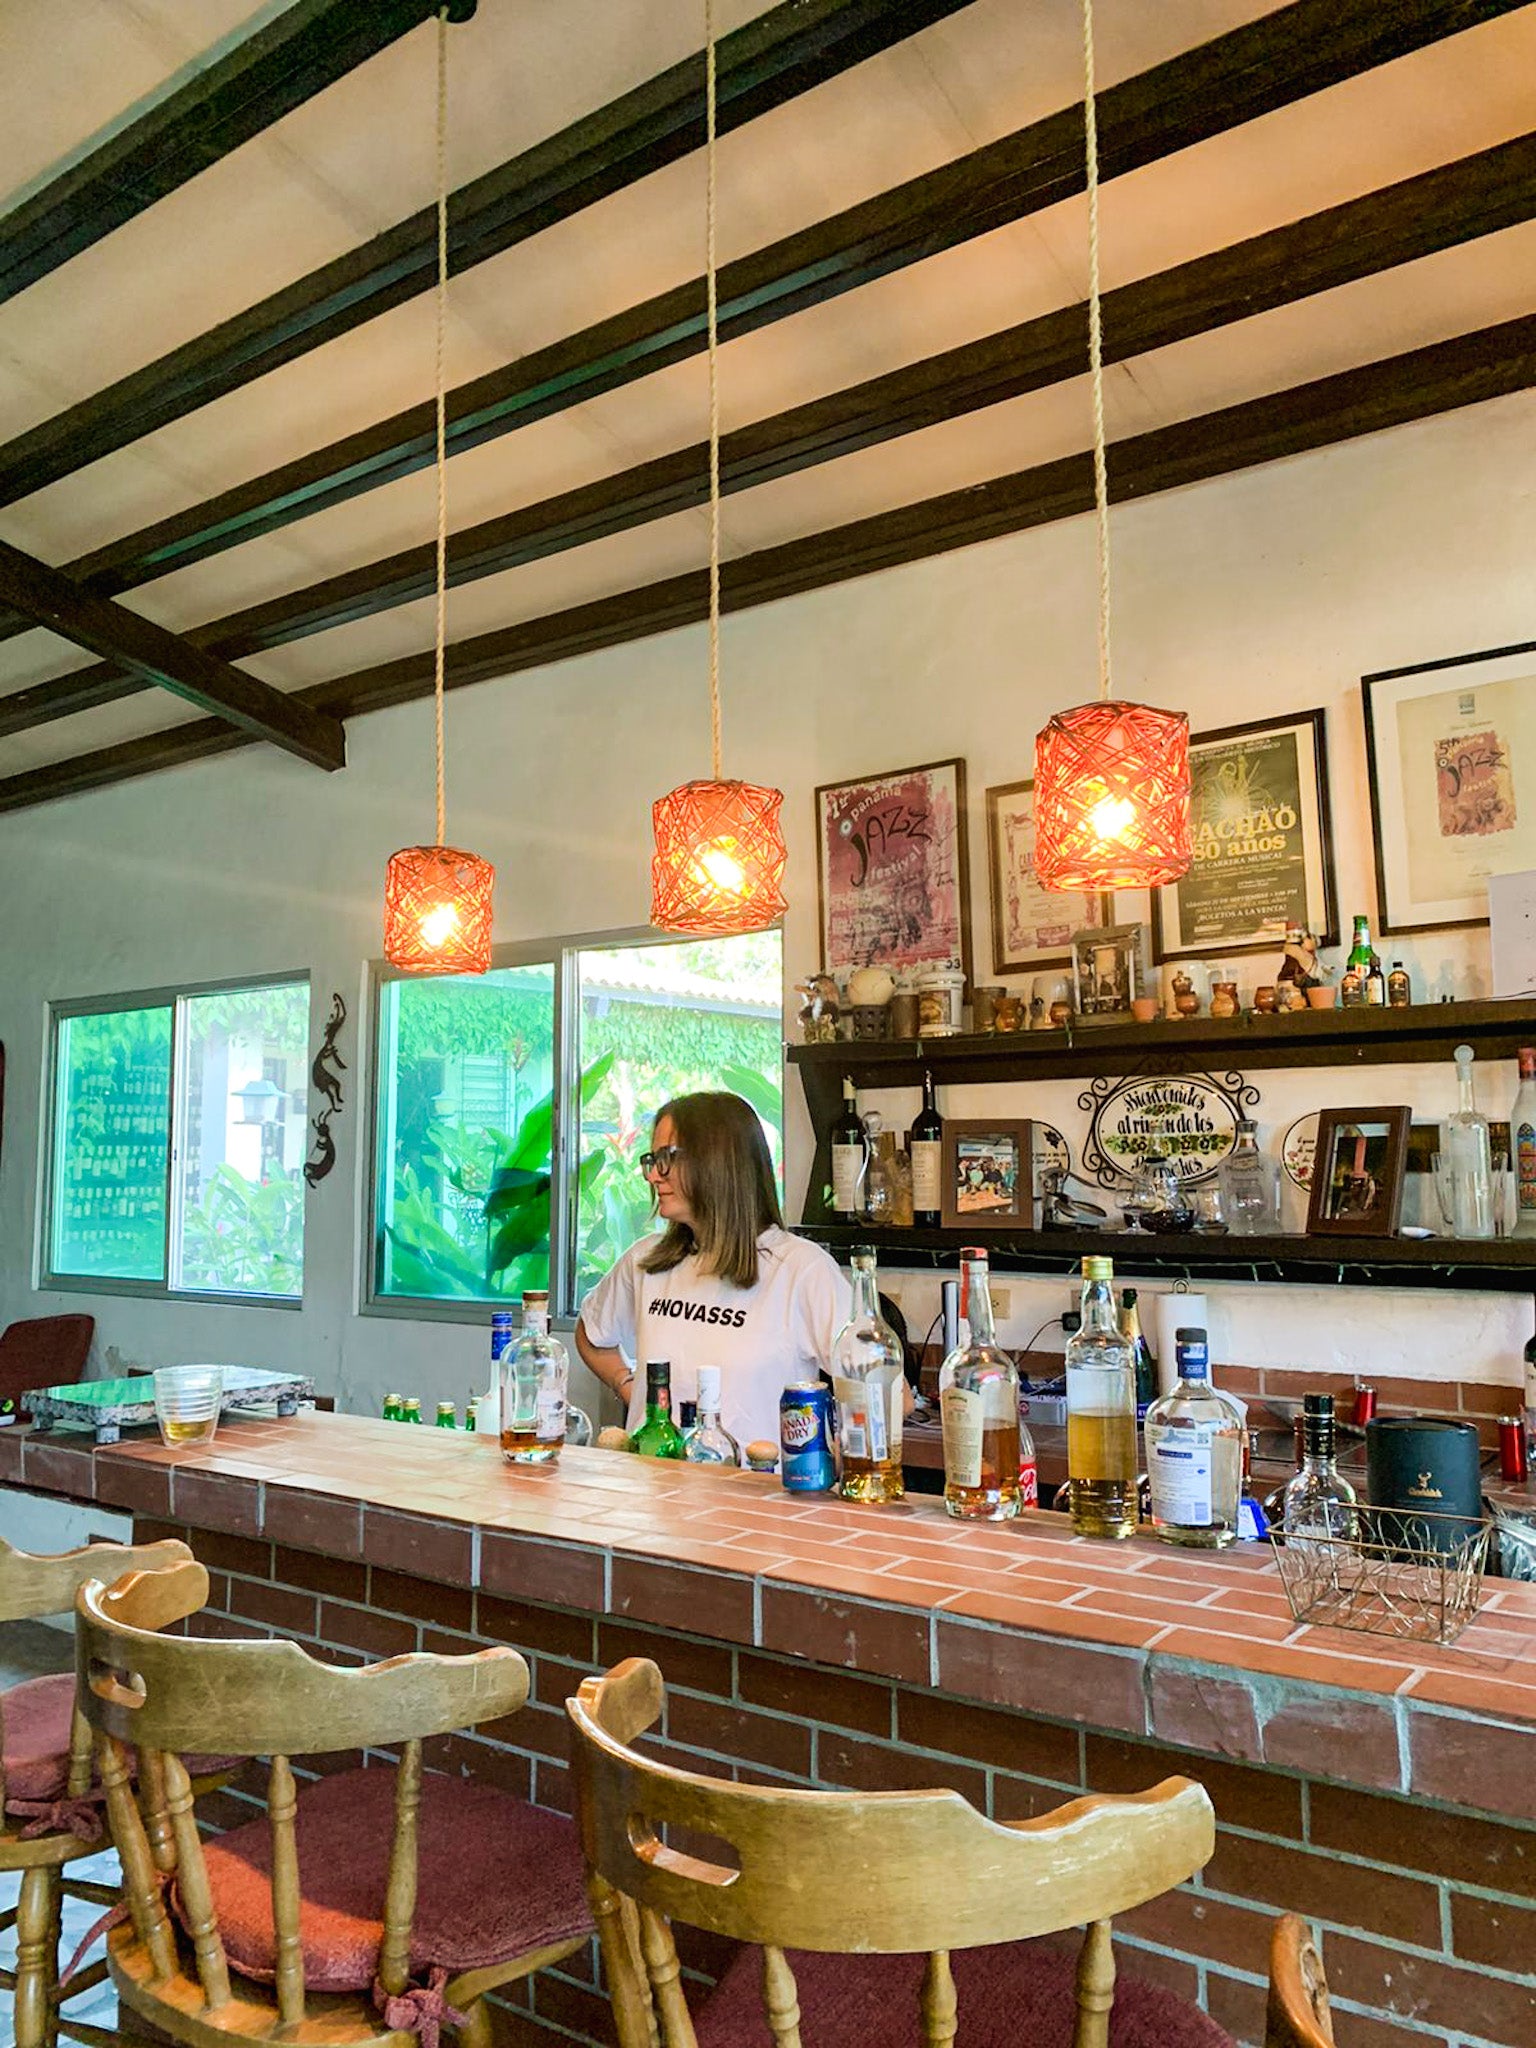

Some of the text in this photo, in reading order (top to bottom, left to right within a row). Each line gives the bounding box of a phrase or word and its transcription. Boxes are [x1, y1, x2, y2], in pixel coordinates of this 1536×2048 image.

[850, 786, 902, 822] panama
[850, 805, 933, 888] JAZZ
[871, 843, 922, 880] festival
[1124, 1086, 1205, 1111] Bienvenidos
[648, 1298, 747, 1328] #NOVASSS
[787, 1426, 809, 1441] DRY
